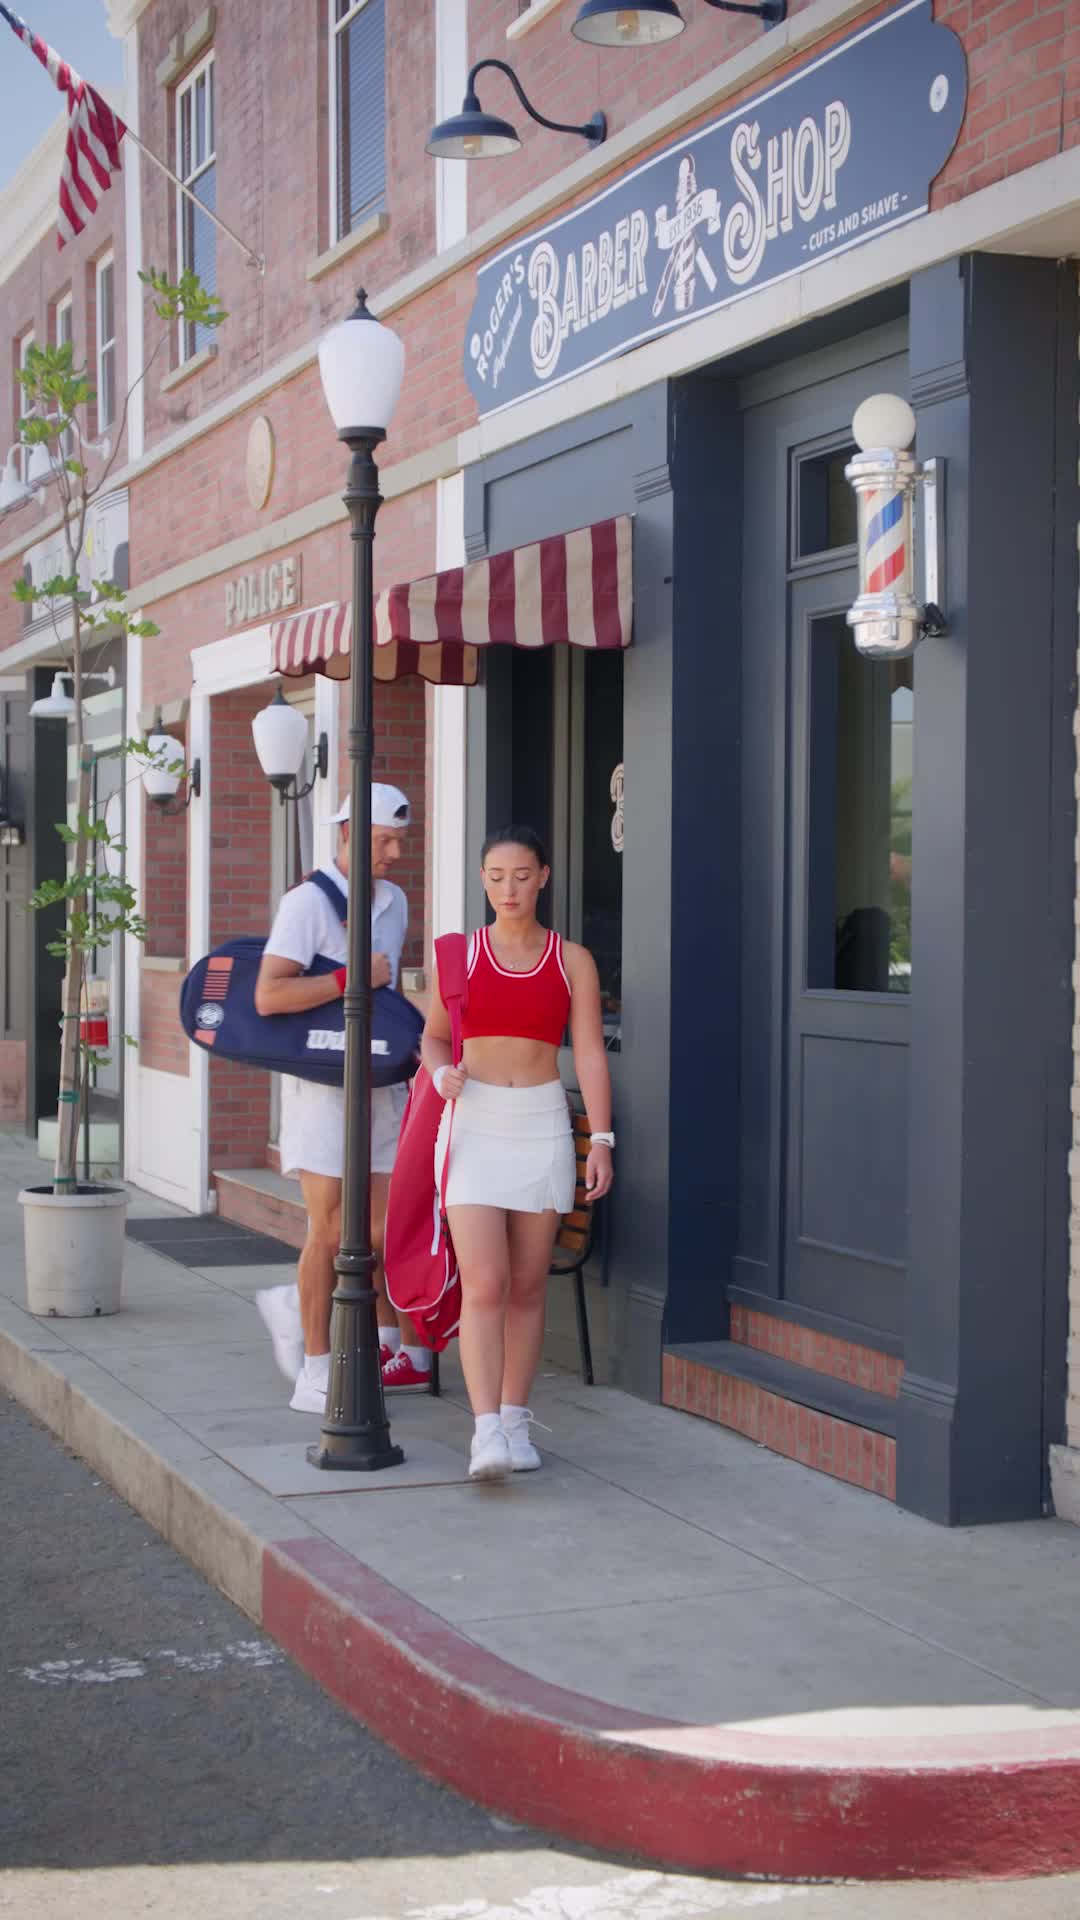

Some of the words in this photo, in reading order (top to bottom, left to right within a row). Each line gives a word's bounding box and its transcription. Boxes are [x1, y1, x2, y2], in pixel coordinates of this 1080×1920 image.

[528, 208, 649, 380] BARBER
[723, 99, 851, 285] SHOP
[683, 197, 704, 232] 1936
[808, 228, 837, 252] CUTS
[836, 213, 861, 239] AND
[860, 191, 900, 226] SHAVE
[476, 254, 525, 382] ROGER'S
[223, 556, 299, 629] POLICE
